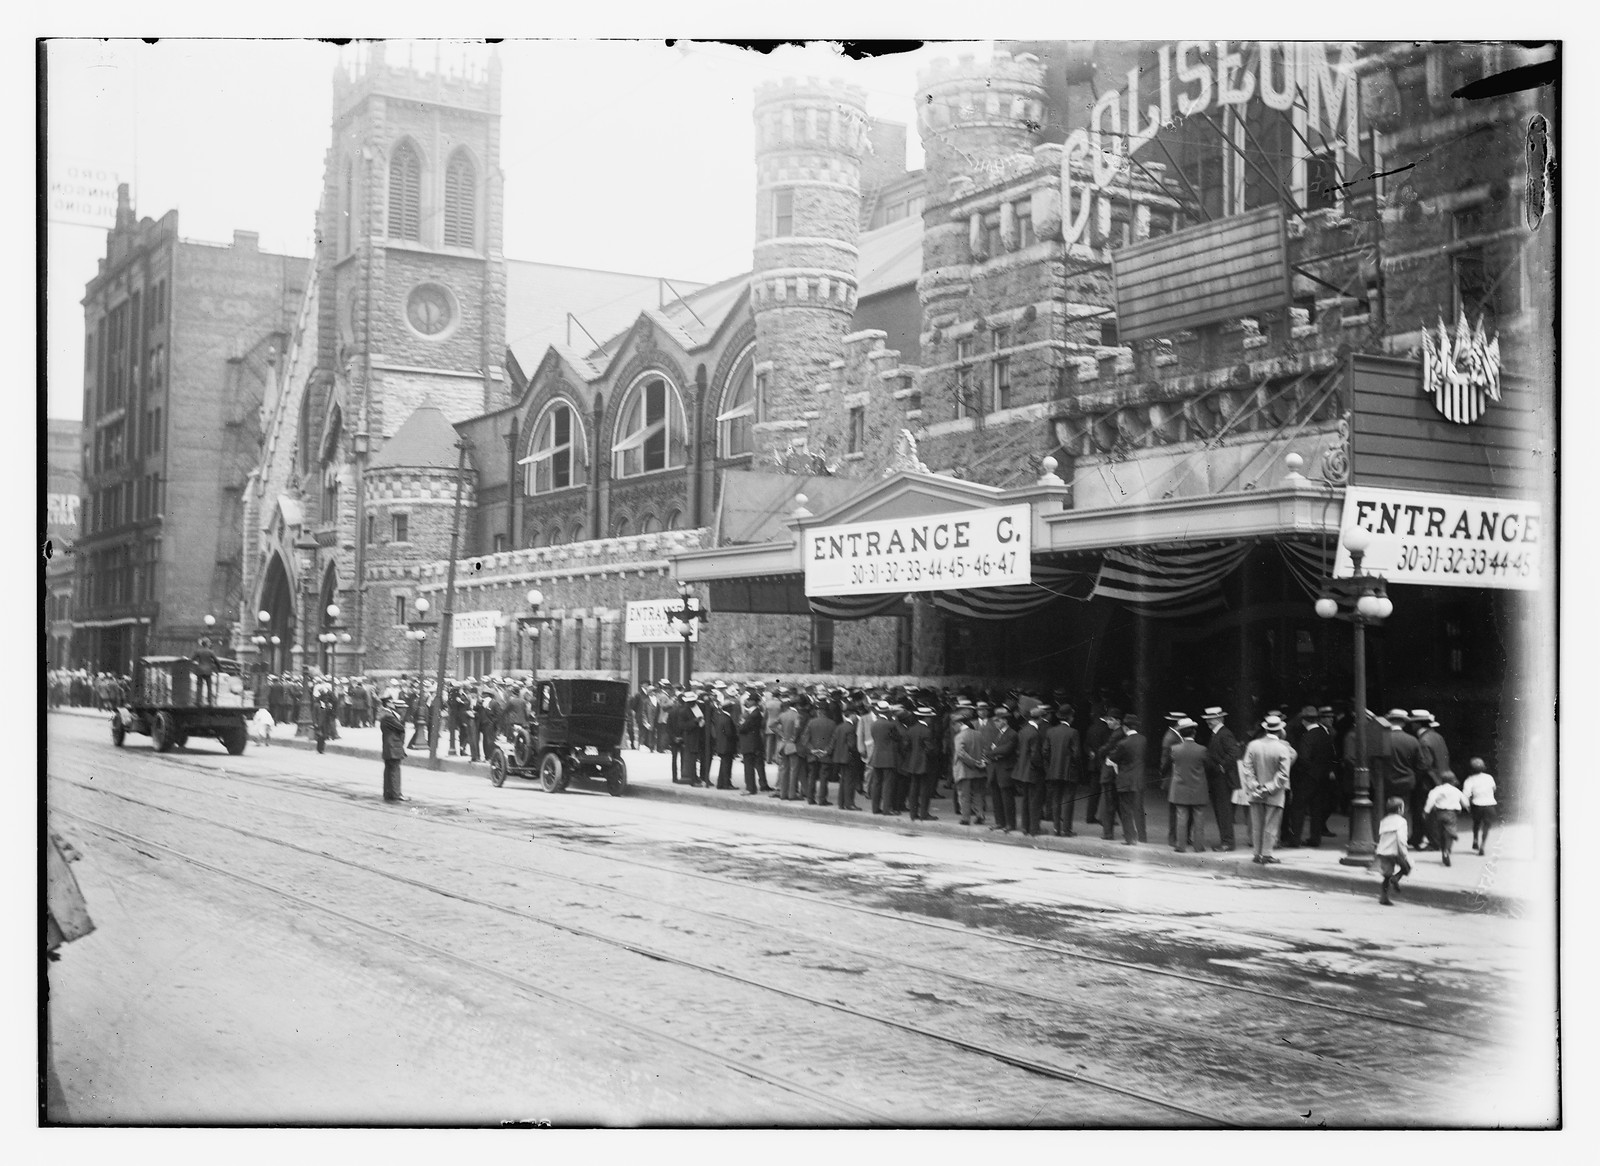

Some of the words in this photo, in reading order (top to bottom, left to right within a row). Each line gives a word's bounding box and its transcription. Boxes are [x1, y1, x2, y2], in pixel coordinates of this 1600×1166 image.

[1060, 41, 1361, 243] COLISEUM
[814, 521, 970, 561] ENTRANCE
[996, 516, 1021, 544] C.
[1356, 501, 1540, 544] ENTRANCE
